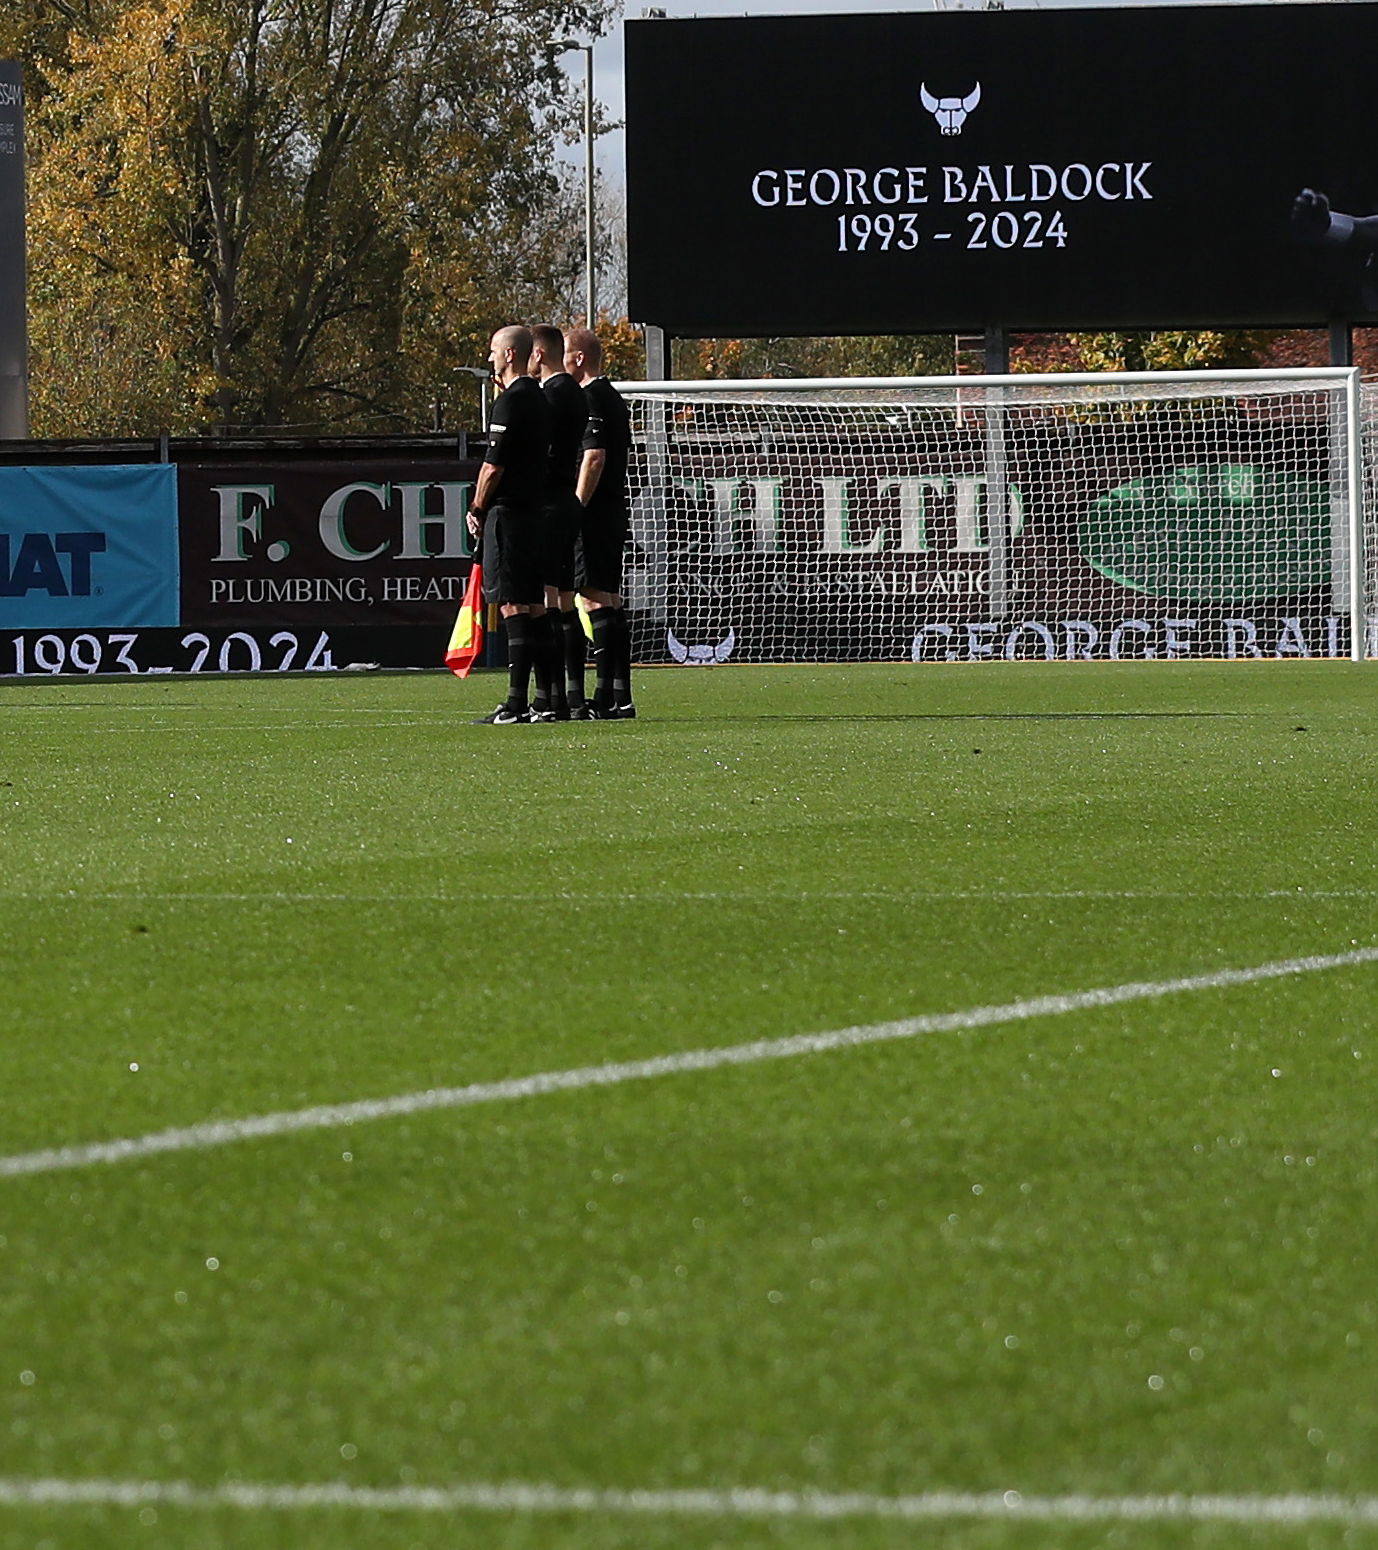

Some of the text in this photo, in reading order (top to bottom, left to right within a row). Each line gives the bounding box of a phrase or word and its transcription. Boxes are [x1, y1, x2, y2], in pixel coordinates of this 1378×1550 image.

[752, 162, 1154, 207] GEORGE BALDOCK
[837, 213, 919, 252] 1993
[966, 210, 1069, 249] 2024
[210, 481, 291, 562] F.
[210, 578, 374, 608] PLUMBING,
